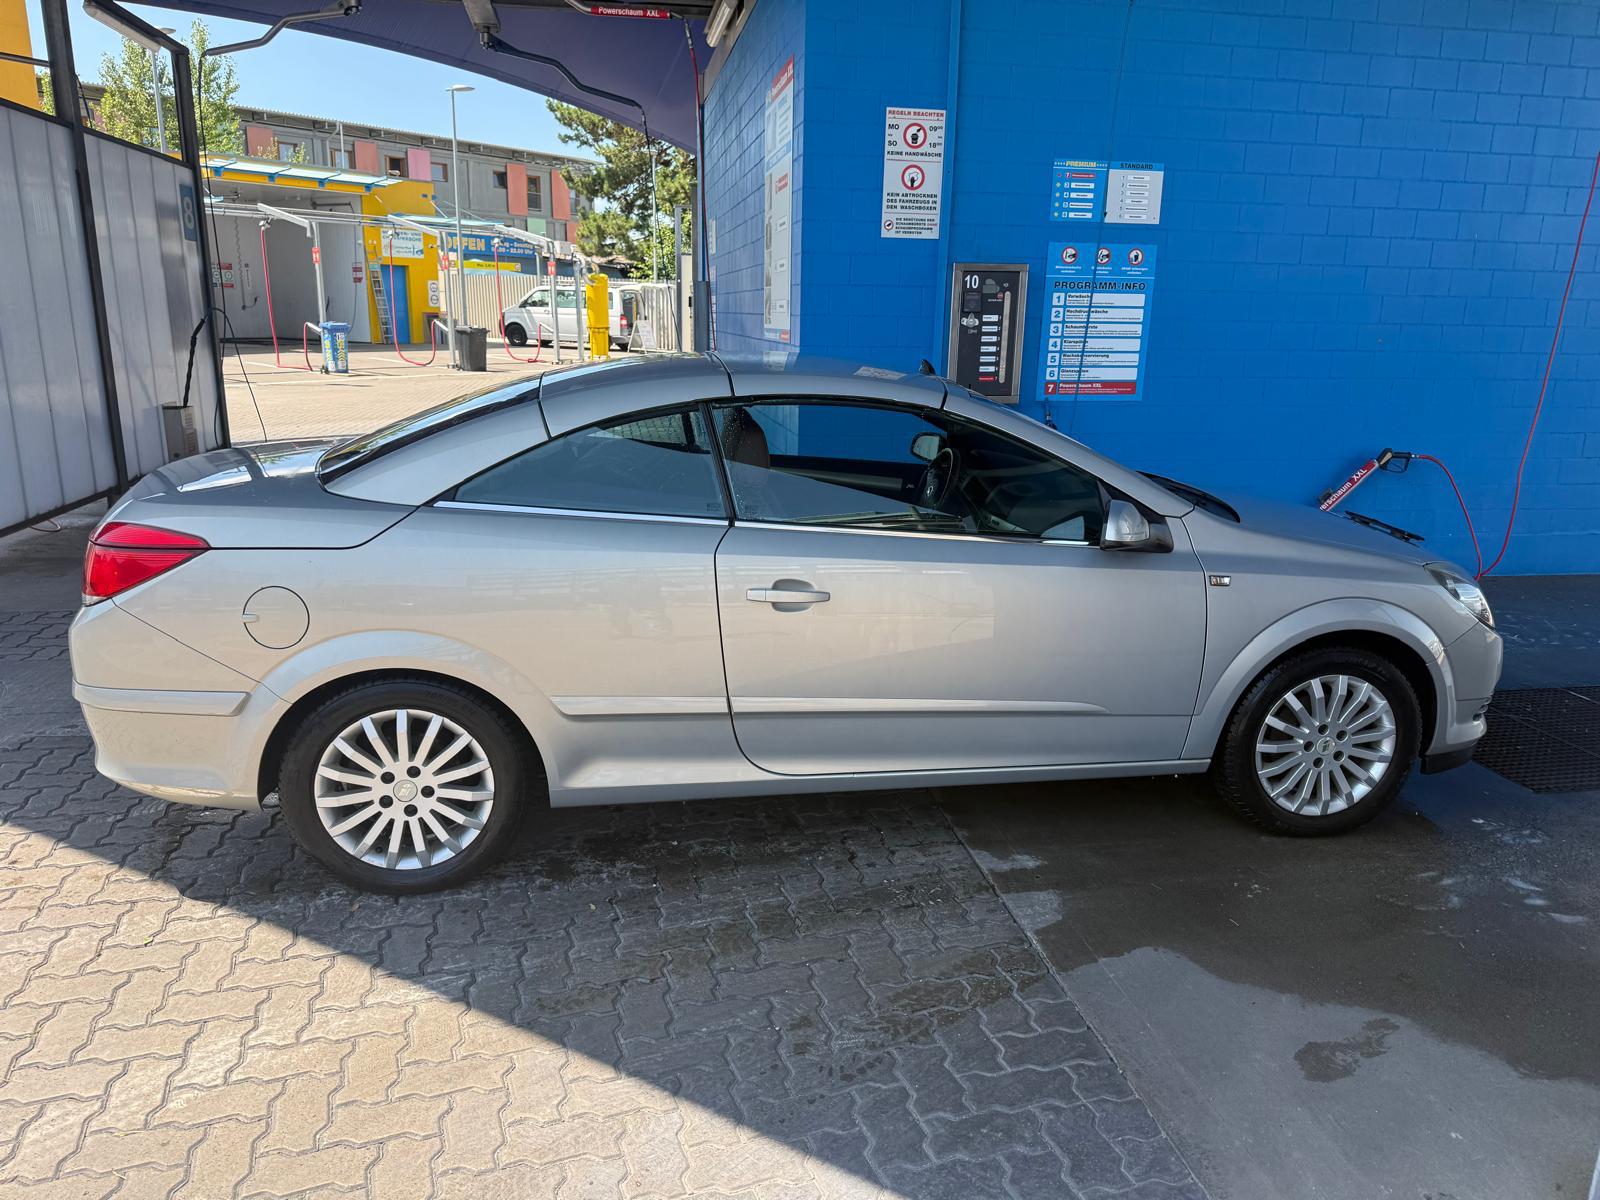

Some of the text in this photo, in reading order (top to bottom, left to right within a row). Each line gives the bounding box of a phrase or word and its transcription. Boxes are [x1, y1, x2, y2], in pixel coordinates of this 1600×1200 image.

[598, 7, 644, 16] Powerschaum
[1120, 162, 1154, 170] STANDARD
[184, 196, 195, 230] 8
[964, 275, 979, 289] 10
[1055, 295, 1061, 303] 1
[1053, 310, 1061, 319] 2
[1052, 325, 1059, 334] 3
[1051, 340, 1058, 348] 4
[1050, 355, 1057, 363] 5
[1047, 384, 1054, 393] 7
[1320, 469, 1368, 510] erschaum XXL
